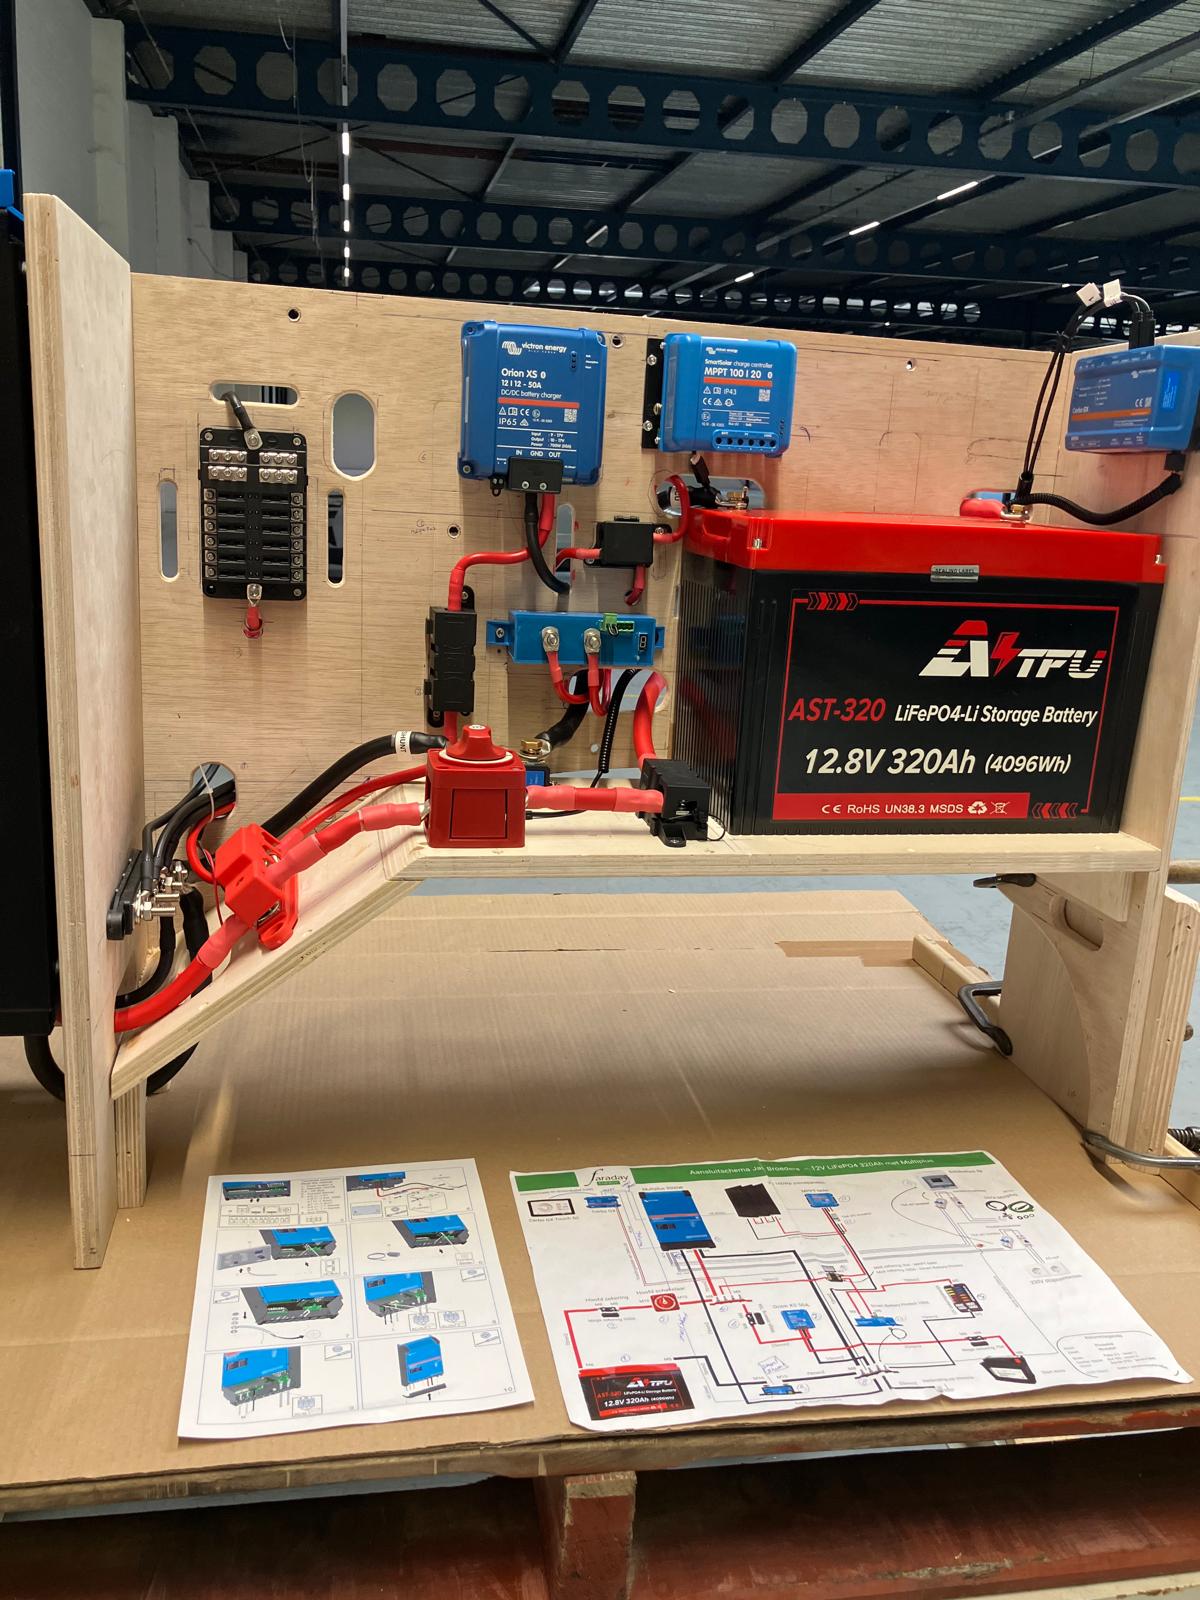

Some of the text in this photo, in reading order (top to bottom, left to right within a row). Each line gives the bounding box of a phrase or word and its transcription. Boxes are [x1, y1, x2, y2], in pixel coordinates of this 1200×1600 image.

[522, 342, 544, 350] victron
[545, 345, 567, 353] energy
[733, 360, 750, 368] charge
[501, 368, 538, 378] Orion XS
[704, 366, 728, 376] MPPT
[520, 390, 540, 398] battery
[541, 392, 562, 400] charger
[788, 698, 1098, 728] AST-320 LiFePO4-Li Storage Battery
[806, 748, 1072, 774] 12.8V 320Ah (4096Wh)
[847, 804, 880, 814] RoHS
[885, 804, 925, 814] UN38.3
[930, 804, 964, 814] MSDS
[690, 1166, 751, 1175] Aansluitschema
